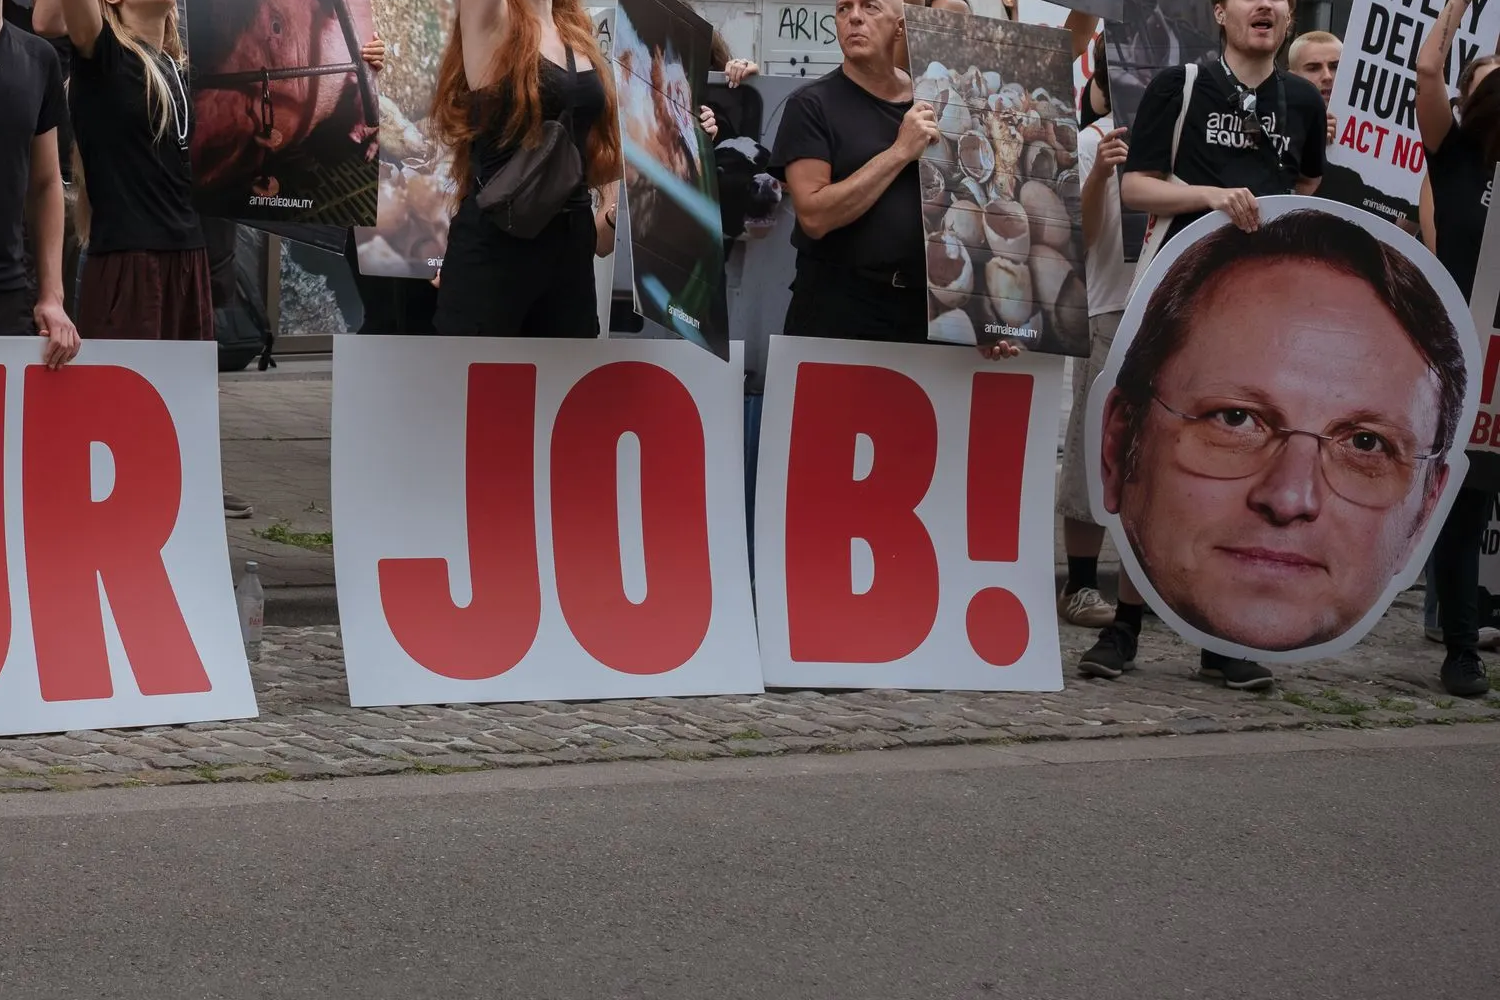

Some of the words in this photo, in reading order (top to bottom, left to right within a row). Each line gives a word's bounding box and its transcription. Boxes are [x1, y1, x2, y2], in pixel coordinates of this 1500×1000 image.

[1361, 2, 1480, 90] DELY
[1348, 57, 1417, 131] HUR
[1206, 110, 1276, 132] anial
[1206, 128, 1291, 151] EQUATY
[1339, 115, 1389, 159] ACT
[1391, 131, 1426, 174] NO
[249, 195, 313, 209] animalEQUALITY
[1362, 198, 1407, 219] animalEQUALITY
[984, 322, 1038, 338] animalEQUALITY
